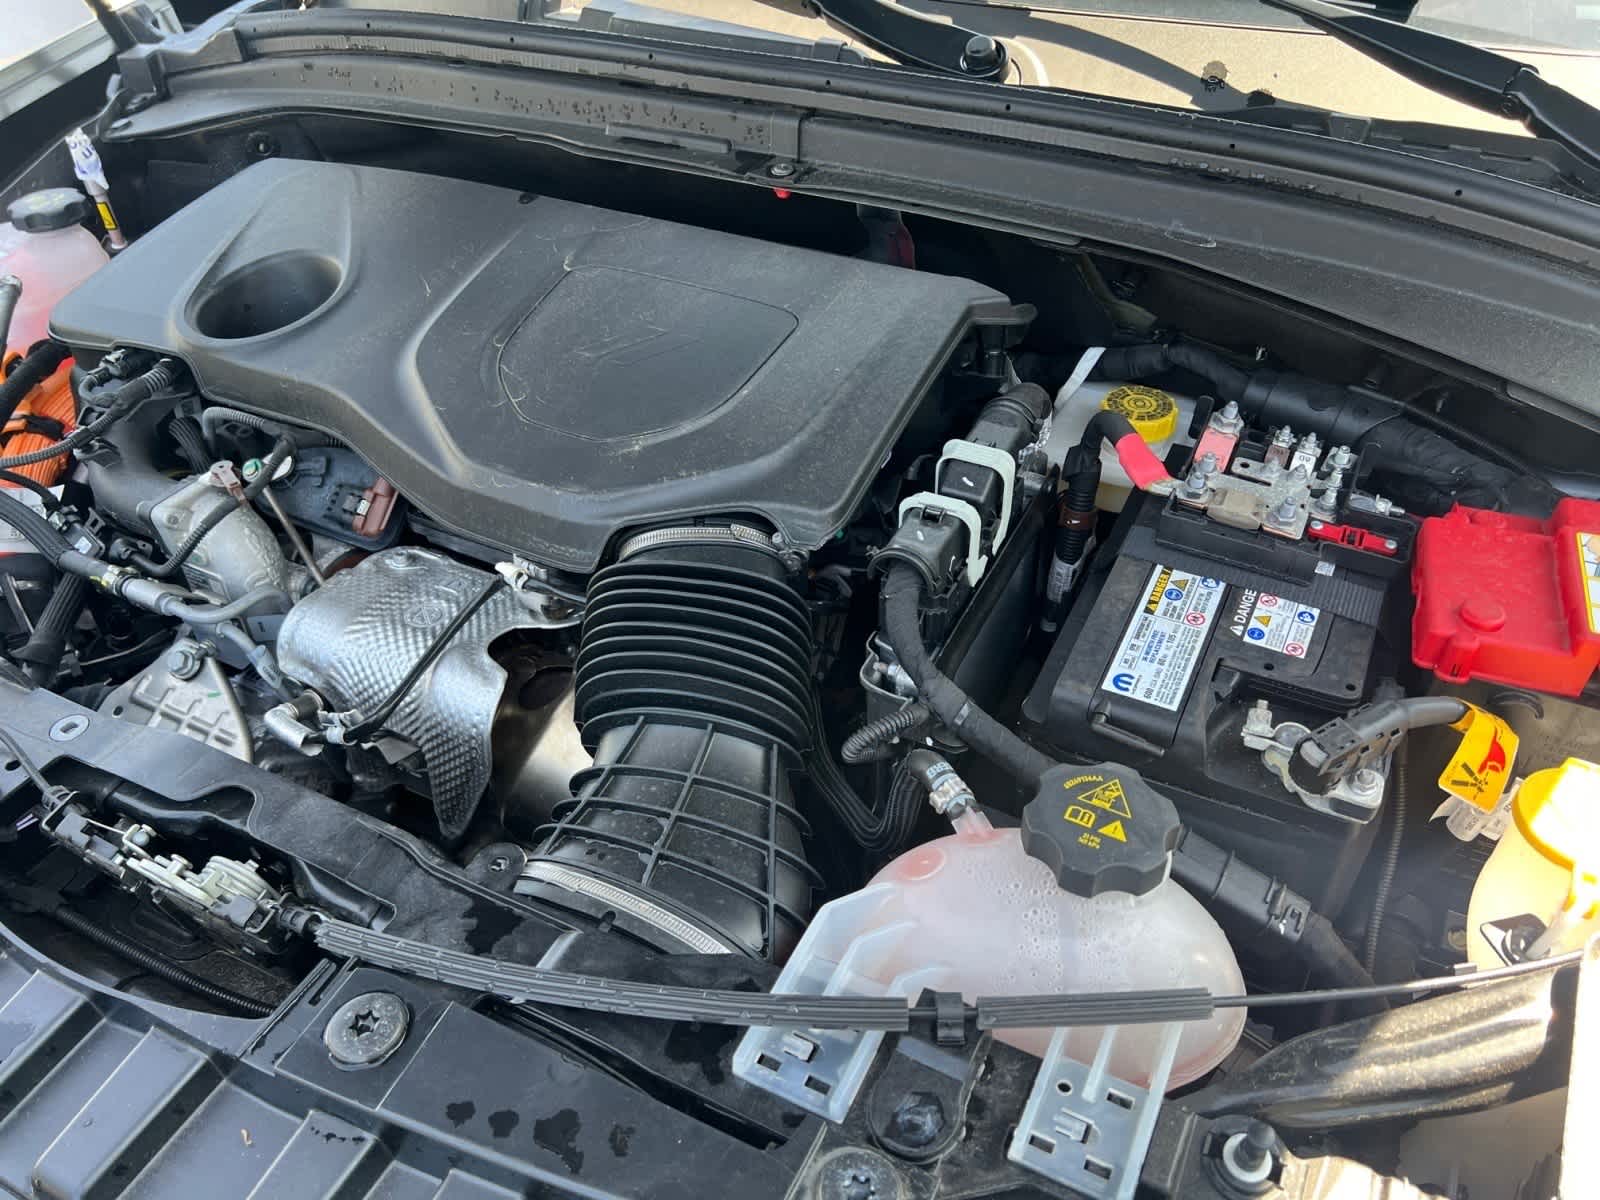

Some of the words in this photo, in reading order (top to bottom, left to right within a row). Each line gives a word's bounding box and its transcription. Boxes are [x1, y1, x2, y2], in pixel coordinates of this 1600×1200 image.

[1149, 573, 1169, 602] DANGER
[1233, 588, 1257, 624] DANGE
[1148, 631, 1167, 663] REPLACEMENT
